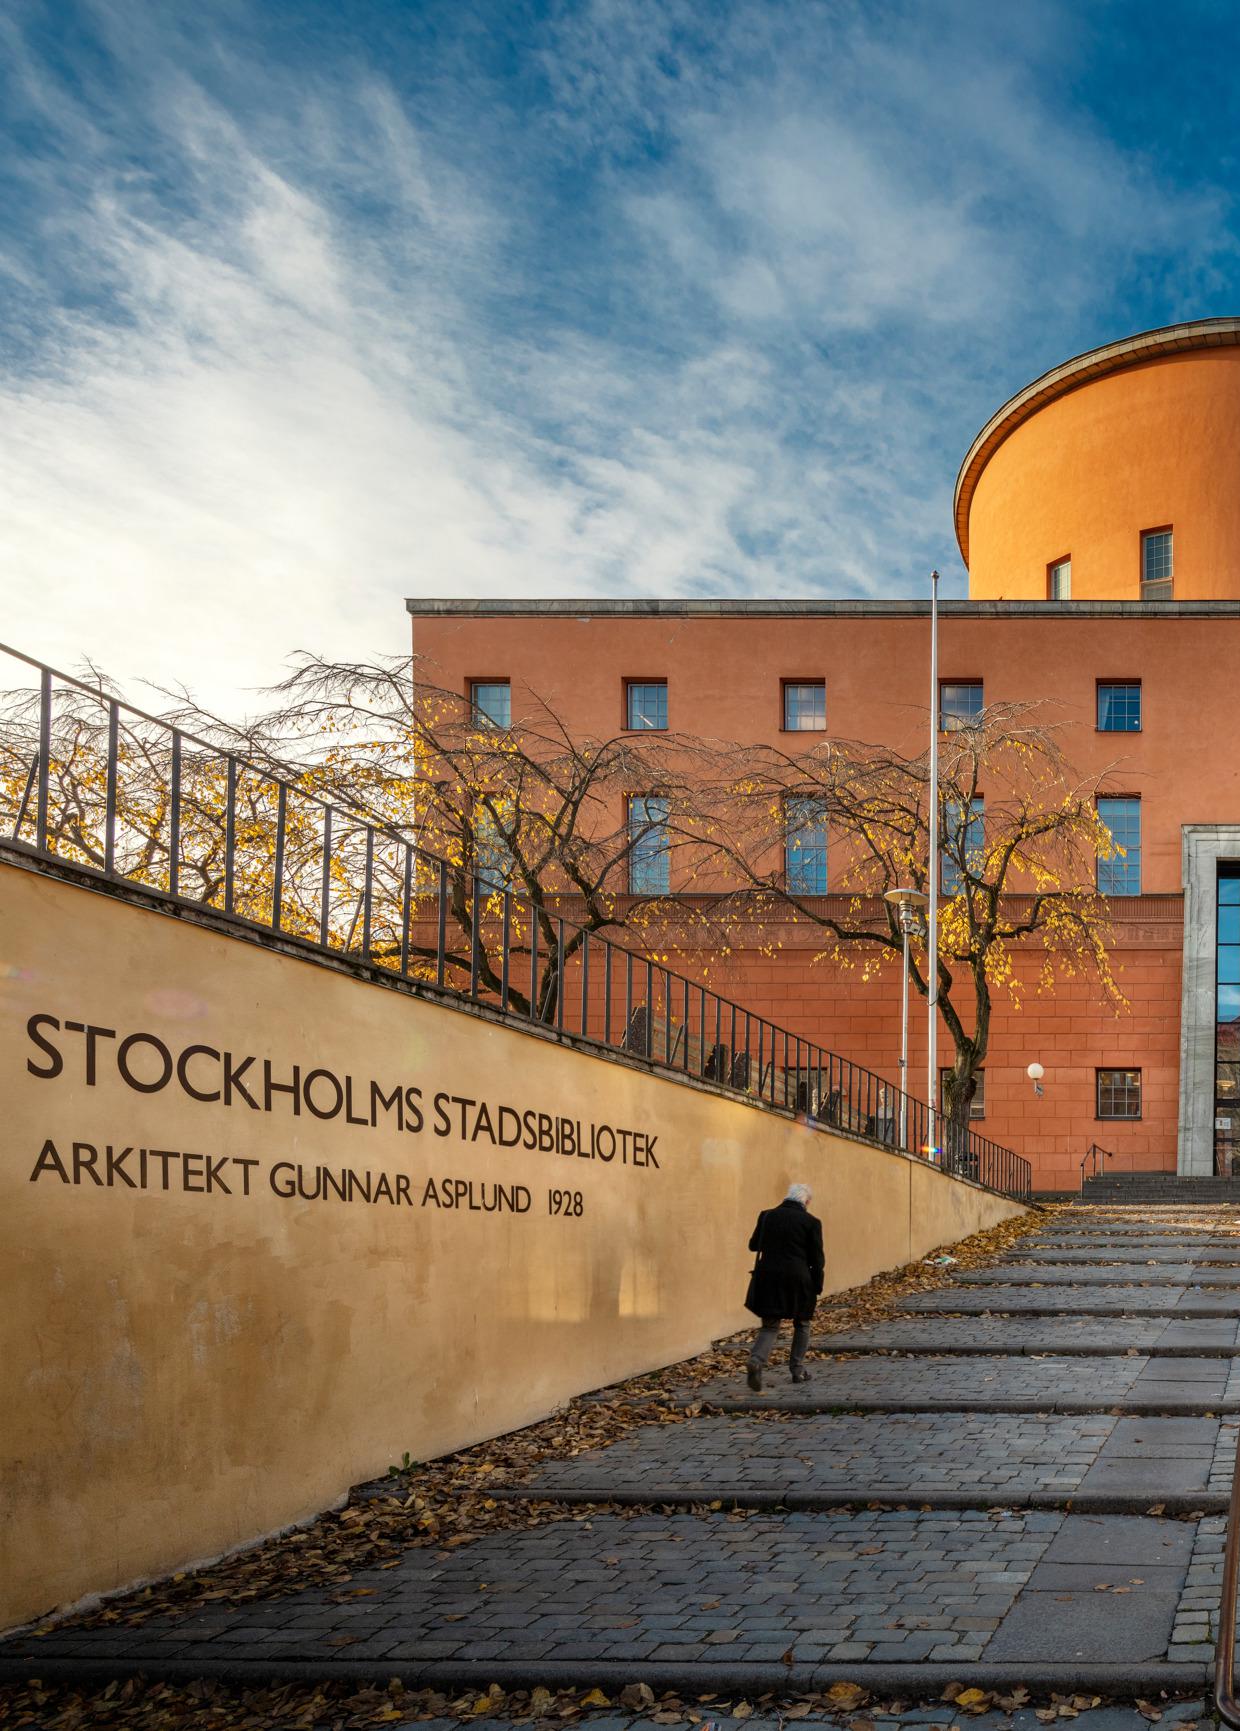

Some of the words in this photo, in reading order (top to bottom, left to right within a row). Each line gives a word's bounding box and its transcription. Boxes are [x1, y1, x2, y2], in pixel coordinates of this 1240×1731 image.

[27, 1014, 424, 1133] STOCKHOLMS
[434, 1093, 660, 1168] STADSBIBLIOTEK
[30, 1140, 259, 1196] ARKITEKT
[269, 1162, 413, 1206] GUNNAR
[421, 1178, 531, 1213] ASPLUND
[548, 1189, 583, 1217] 1928
